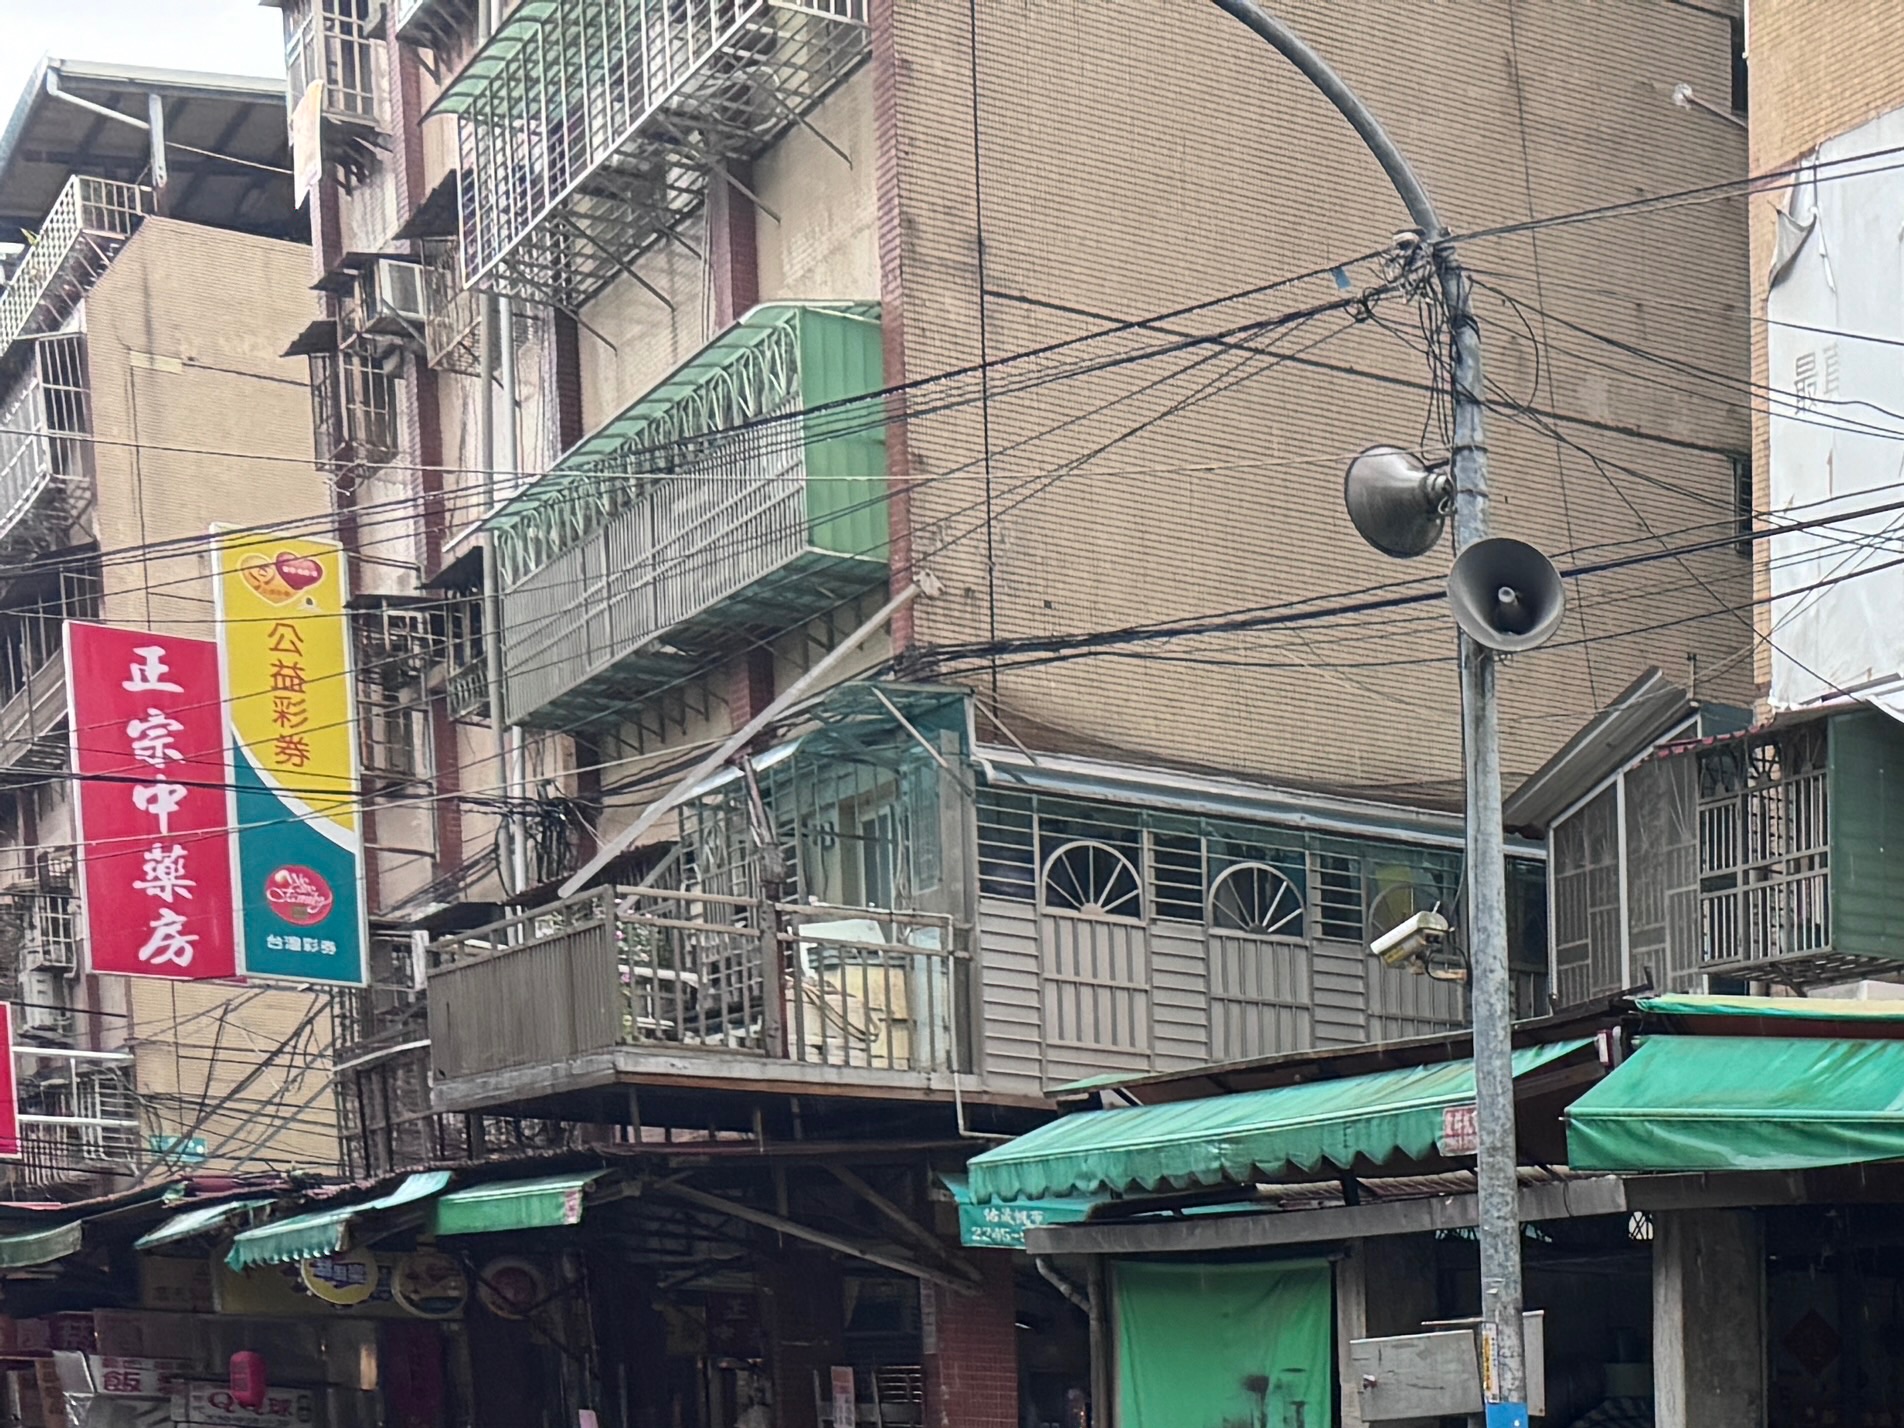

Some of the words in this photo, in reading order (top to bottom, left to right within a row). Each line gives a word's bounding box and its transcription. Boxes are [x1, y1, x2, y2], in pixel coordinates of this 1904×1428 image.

[121, 645, 200, 969] 正宗中藥房
[267, 621, 311, 768] 公益彩券
